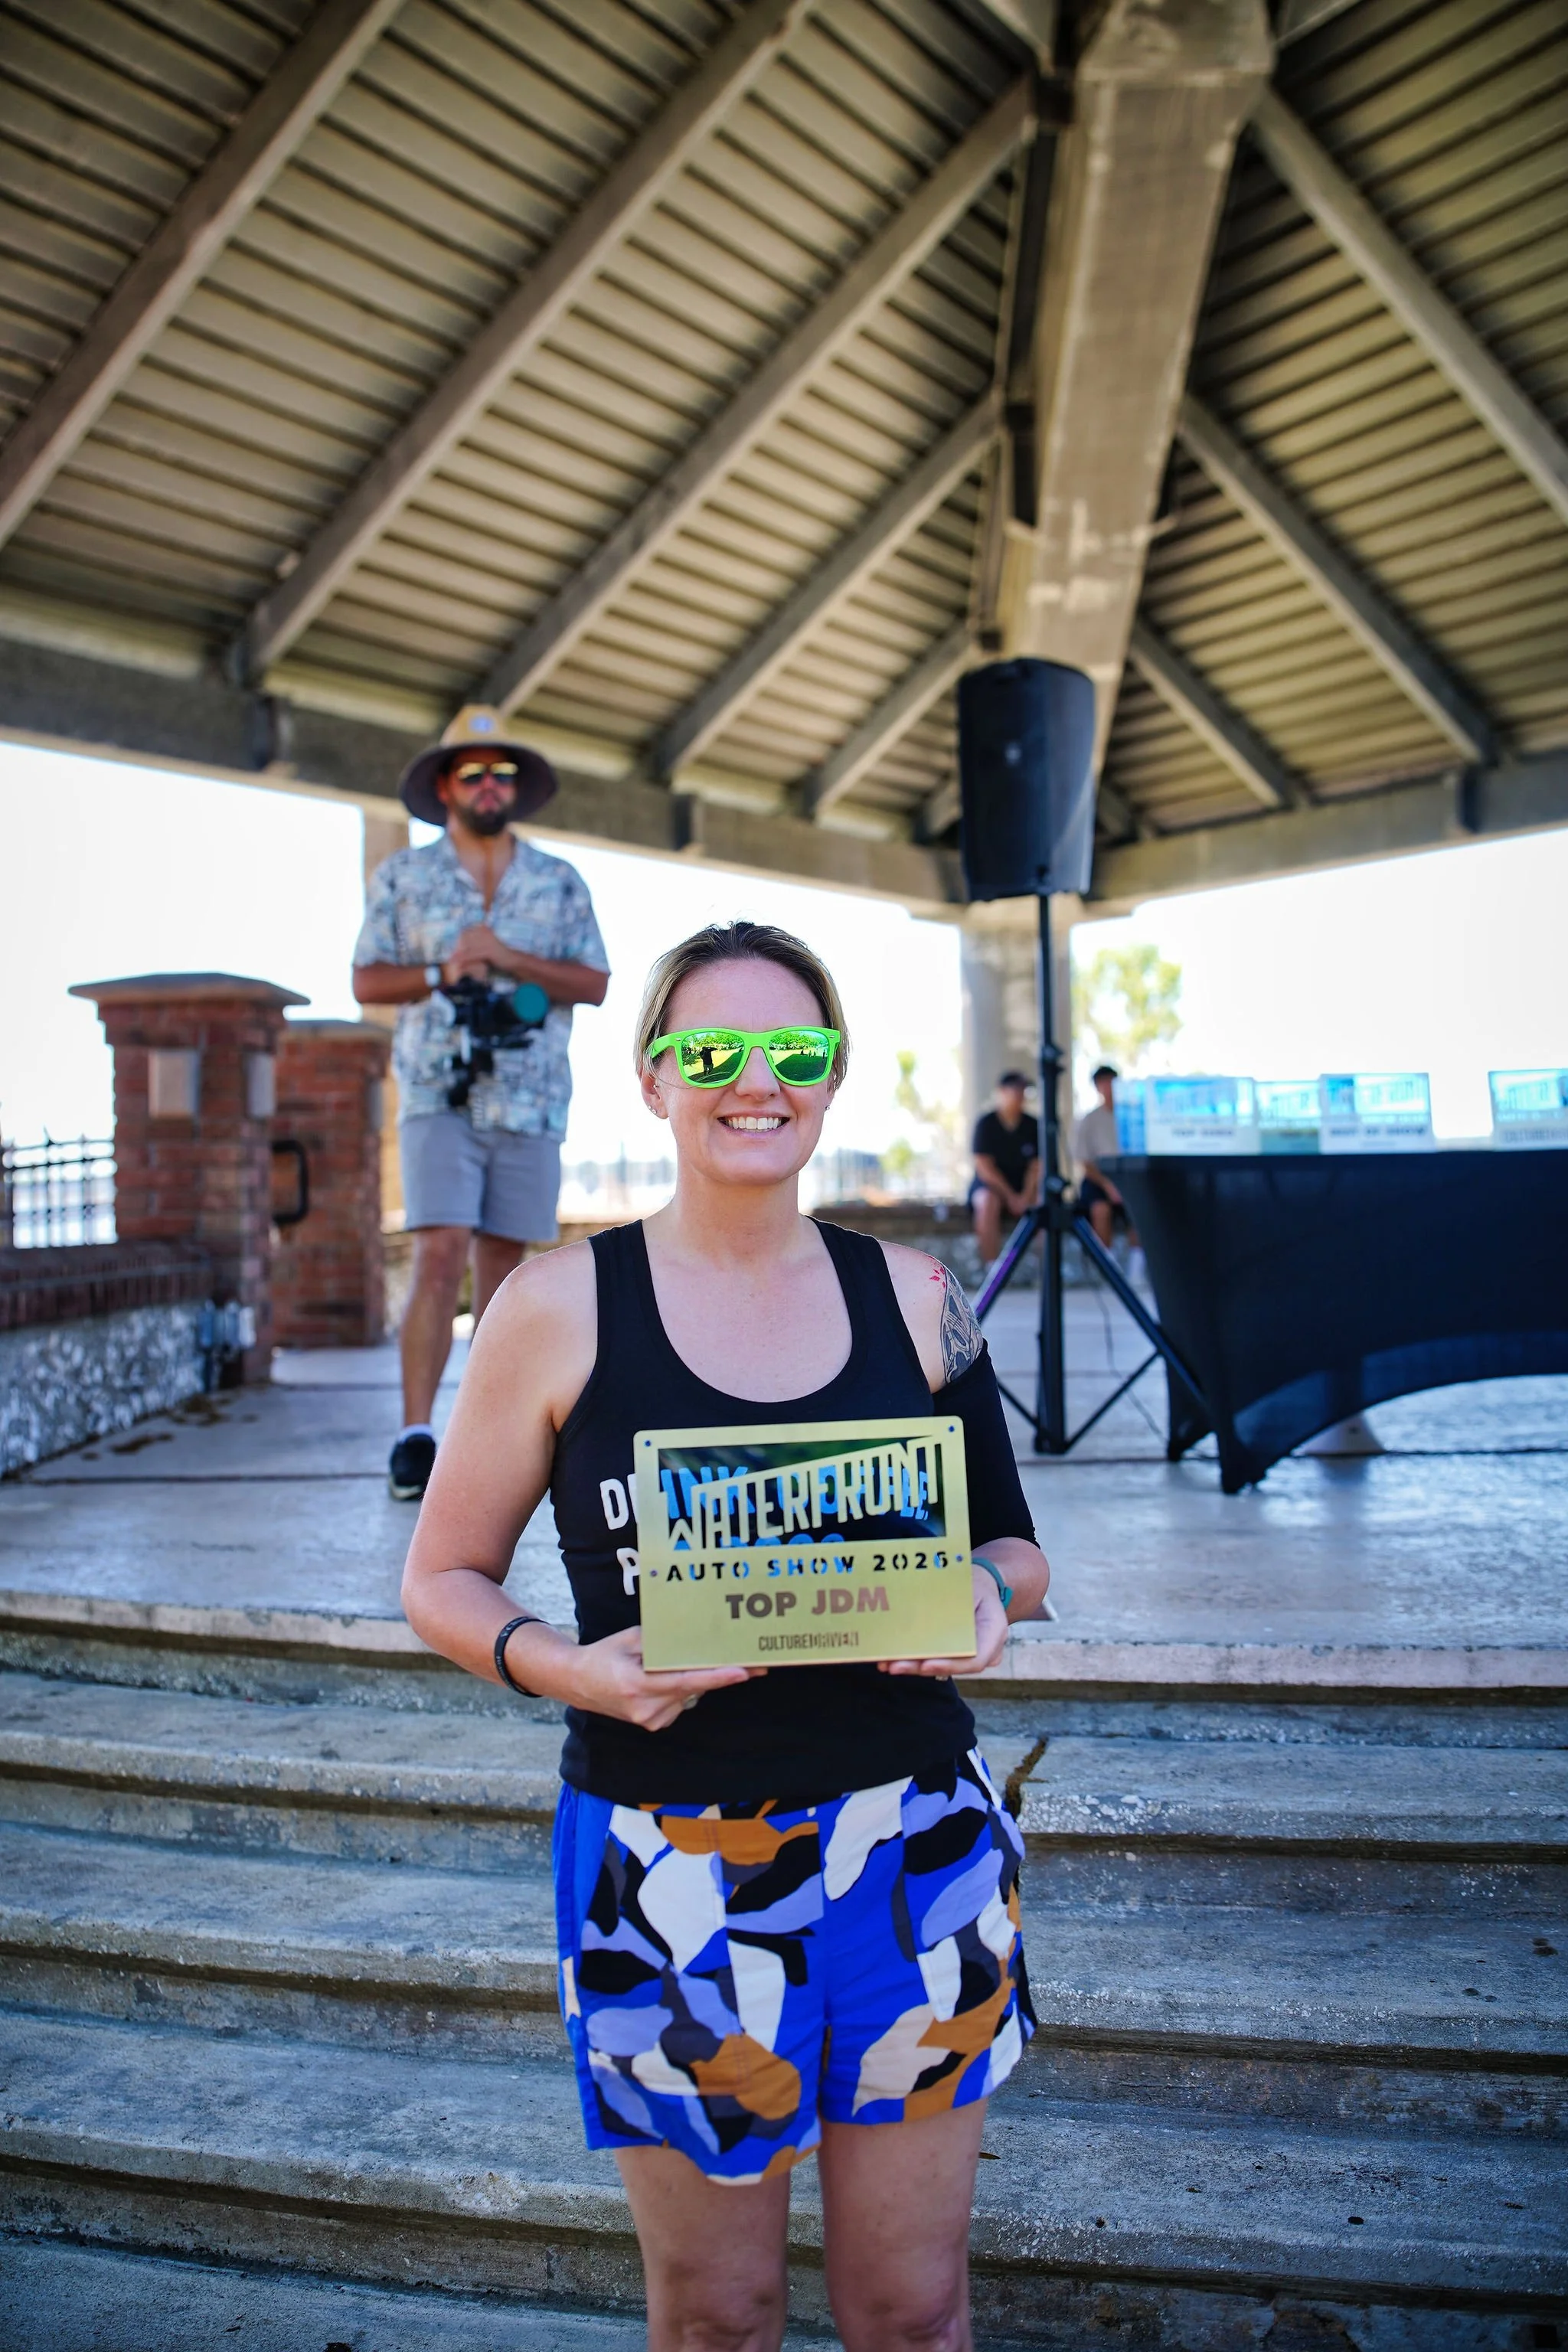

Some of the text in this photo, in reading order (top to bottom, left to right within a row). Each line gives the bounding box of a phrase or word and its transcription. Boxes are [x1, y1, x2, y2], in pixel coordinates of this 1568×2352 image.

[657, 1436, 940, 1548] WATERFRONT
[667, 1561, 750, 1583] AUTO
[768, 1556, 854, 1577] SHOW
[873, 1551, 948, 1572] 2026
[725, 1586, 890, 1619] TOP JDM
